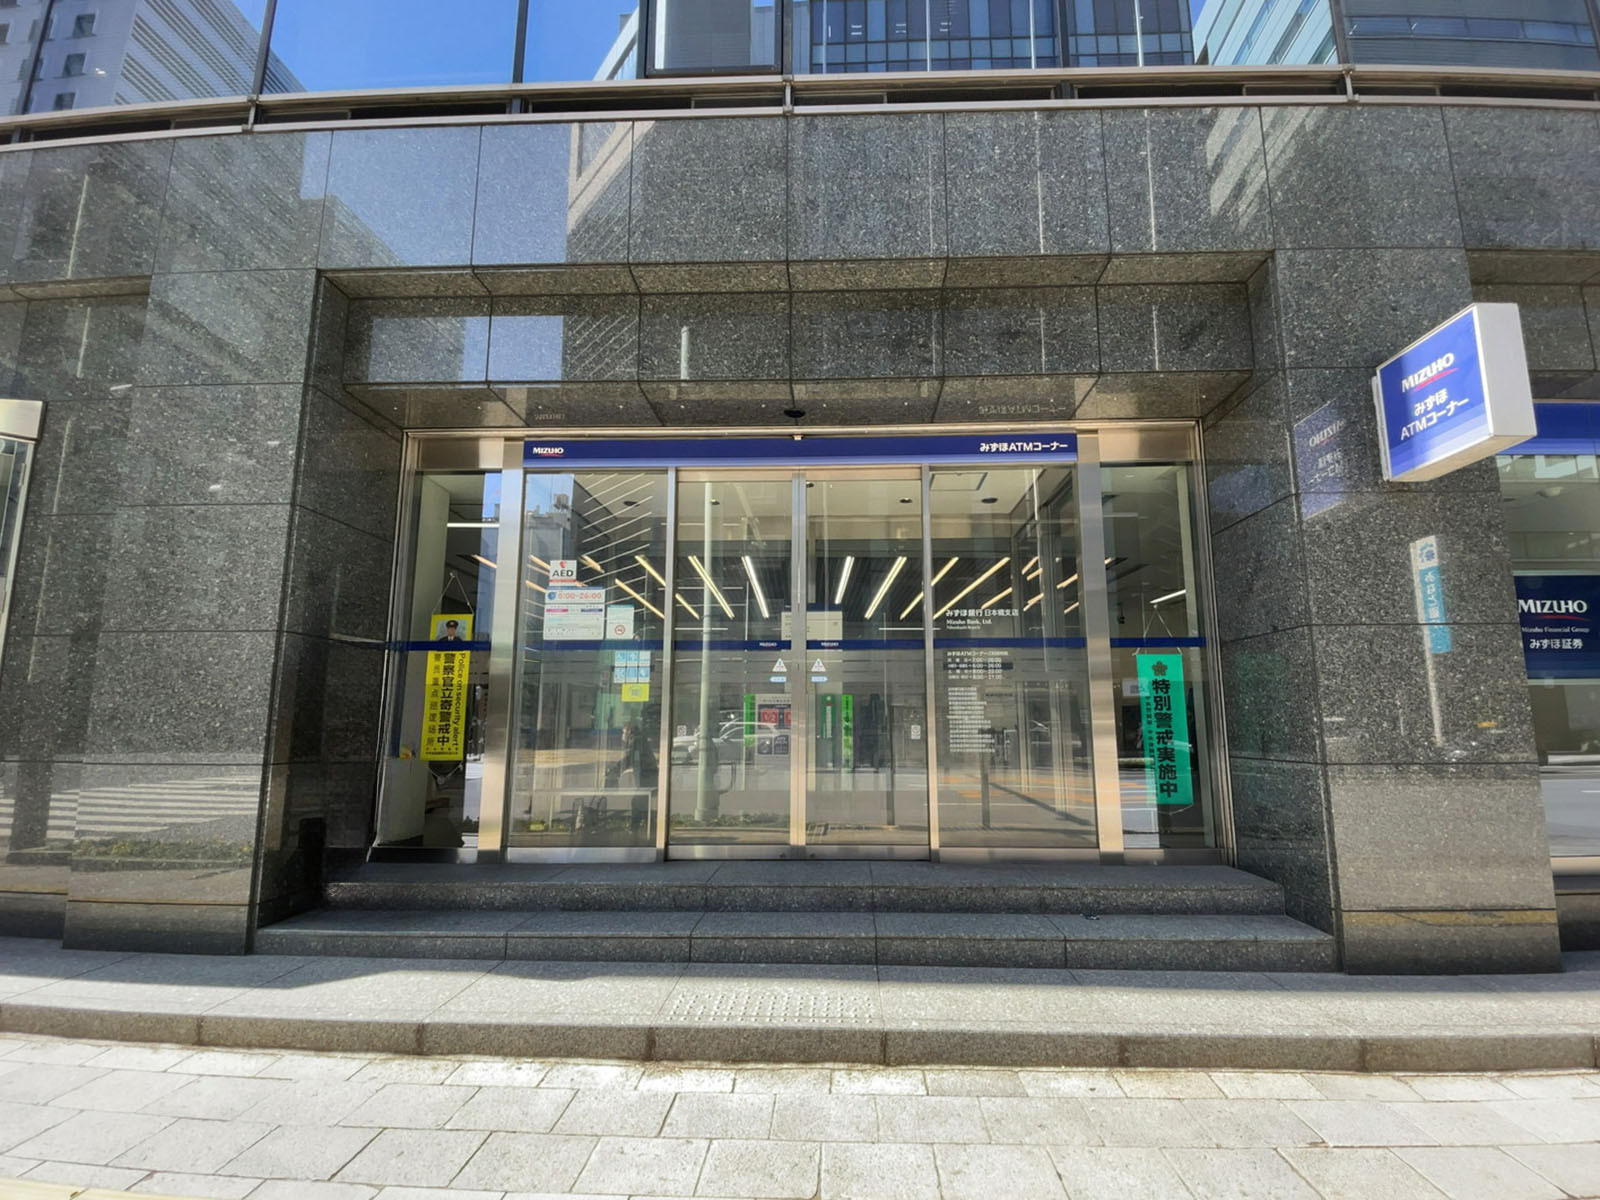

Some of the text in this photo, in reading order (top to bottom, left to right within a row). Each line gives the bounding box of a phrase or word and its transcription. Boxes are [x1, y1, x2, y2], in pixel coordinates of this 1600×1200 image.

[1401, 352, 1455, 393] MIZUHO
[1413, 388, 1448, 416] みずほ
[1400, 398, 1470, 441] ATMコーナー
[979, 441, 1068, 452] みずほATMコーナー
[552, 569, 574, 577] AED
[1518, 599, 1588, 613] MIZUHO
[1529, 638, 1583, 649] みずほ証券
[457, 653, 466, 679] Police
[1151, 679, 1178, 798] 特別警戒実施中
